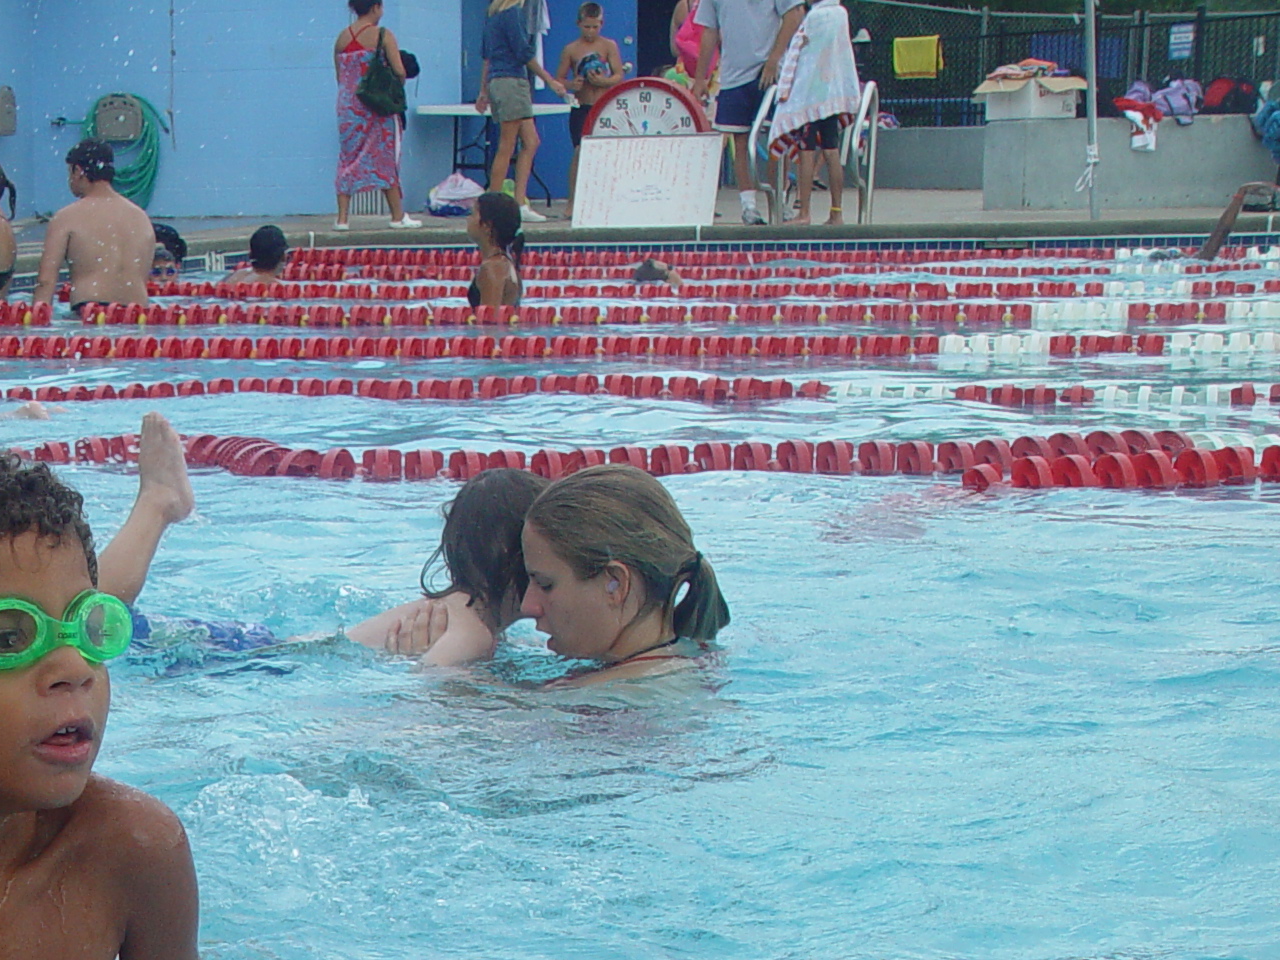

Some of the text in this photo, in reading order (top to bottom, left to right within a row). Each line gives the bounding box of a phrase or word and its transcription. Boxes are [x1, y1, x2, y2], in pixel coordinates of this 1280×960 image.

[639, 91, 652, 103] 60
[616, 98, 628, 110] 55
[665, 98, 672, 109] 5
[599, 117, 612, 129] 50
[680, 116, 691, 128] 10
